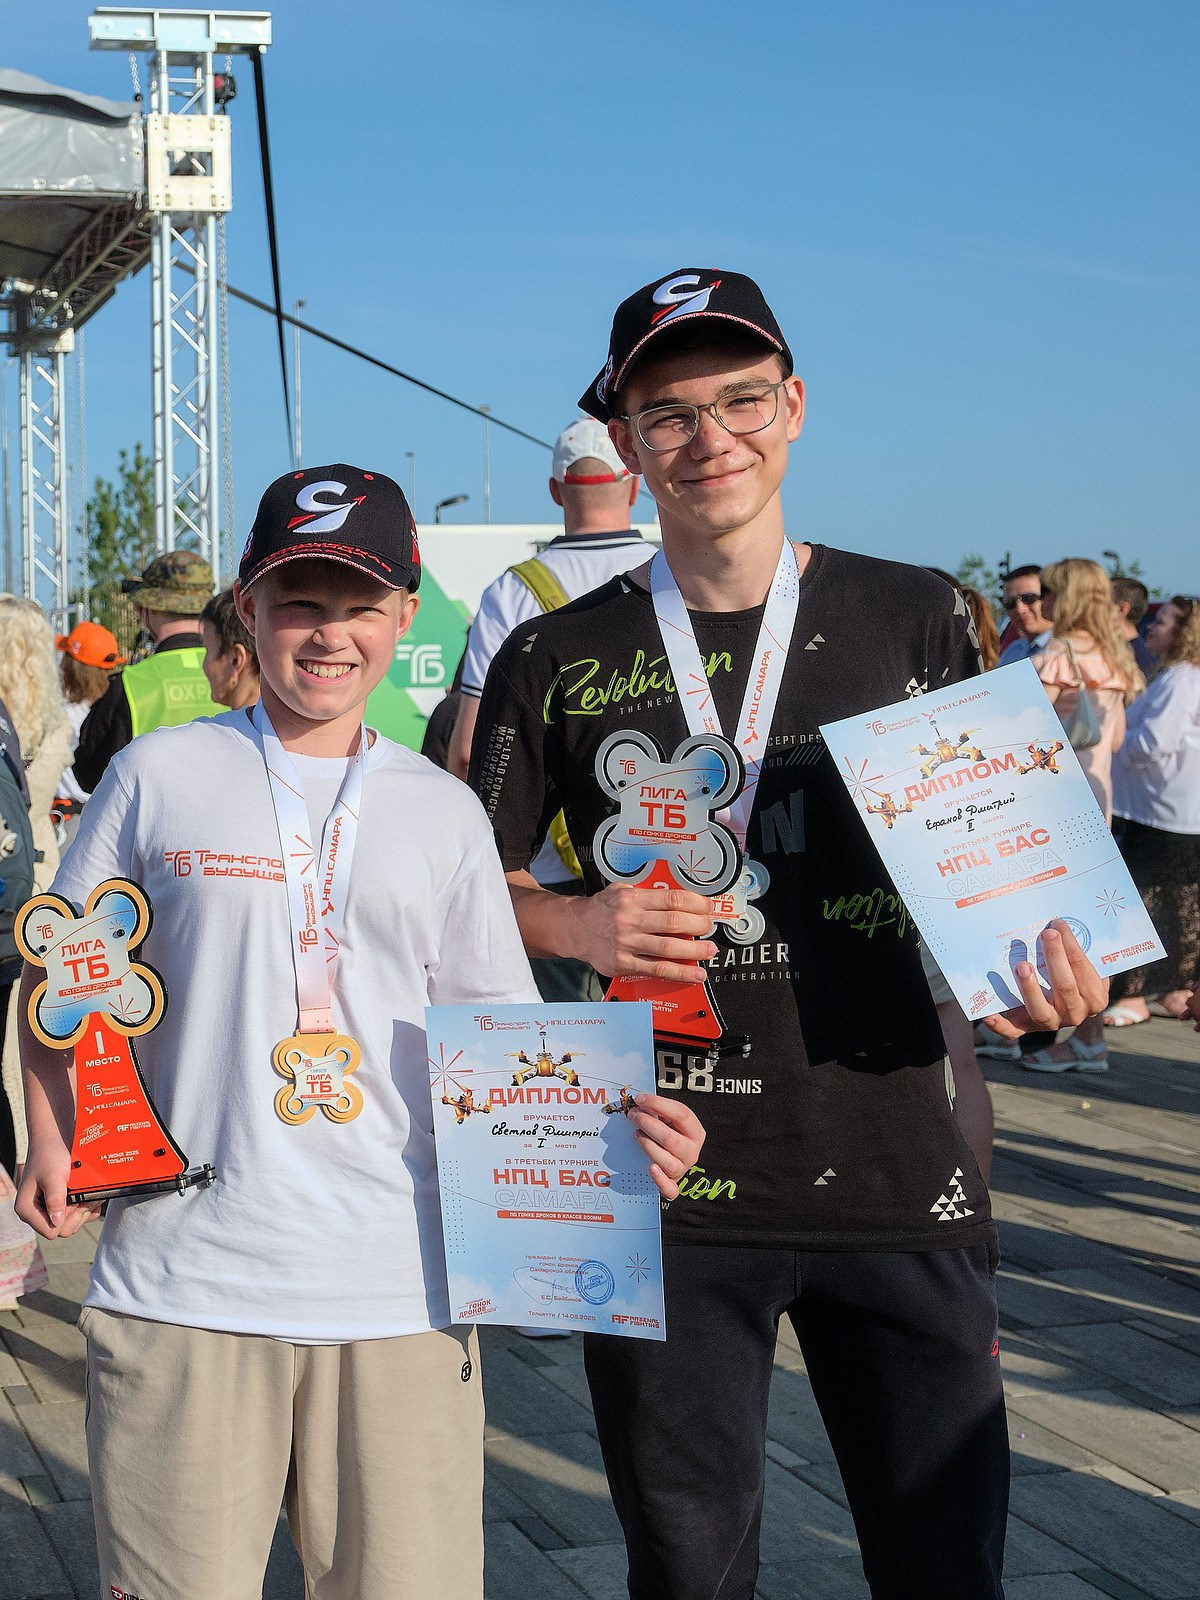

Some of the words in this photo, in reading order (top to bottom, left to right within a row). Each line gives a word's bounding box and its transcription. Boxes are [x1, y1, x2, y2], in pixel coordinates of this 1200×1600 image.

[754, 650, 772, 701] САМАРА
[169, 683, 208, 702] ОХР
[620, 703, 642, 715] THE
[647, 694, 675, 709] NEW
[767, 734, 796, 747] CEPT
[800, 733, 823, 745] DES
[904, 752, 1017, 802] ДИПЛОМ
[488, 776, 503, 820] CONCEP
[640, 786, 687, 801] ЛИГА
[943, 788, 993, 809] ВРУЧАЕТСЯ
[640, 802, 687, 829] ТБ
[992, 821, 1032, 839] ТУРНИРЕ
[327, 816, 342, 871] САМАРА
[936, 847, 992, 877] НПЦ
[995, 828, 1050, 858] БАС
[946, 847, 1062, 897] САМАРА
[322, 872, 333, 901] НПЦ
[61, 938, 107, 958] ЛИГА
[708, 943, 790, 968] EADER
[63, 953, 110, 984] ТБ
[715, 971, 800, 983] GENERATION
[306, 1081, 332, 1093] ТБ
[489, 1087, 606, 1107] ДИПЛОМ
[491, 1122, 539, 1136] Светлов
[542, 1125, 600, 1138] Дмитрий
[514, 1158, 556, 1166] ТРЕТЬЕМ
[559, 1159, 599, 1167] ТУРНИРЕ
[493, 1168, 549, 1188] НПЦ
[559, 1169, 611, 1188] БАС
[495, 1188, 614, 1211] САМАРА
[459, 1306, 487, 1319] ДРОНОВ
[469, 1299, 491, 1309] ГОНОК
